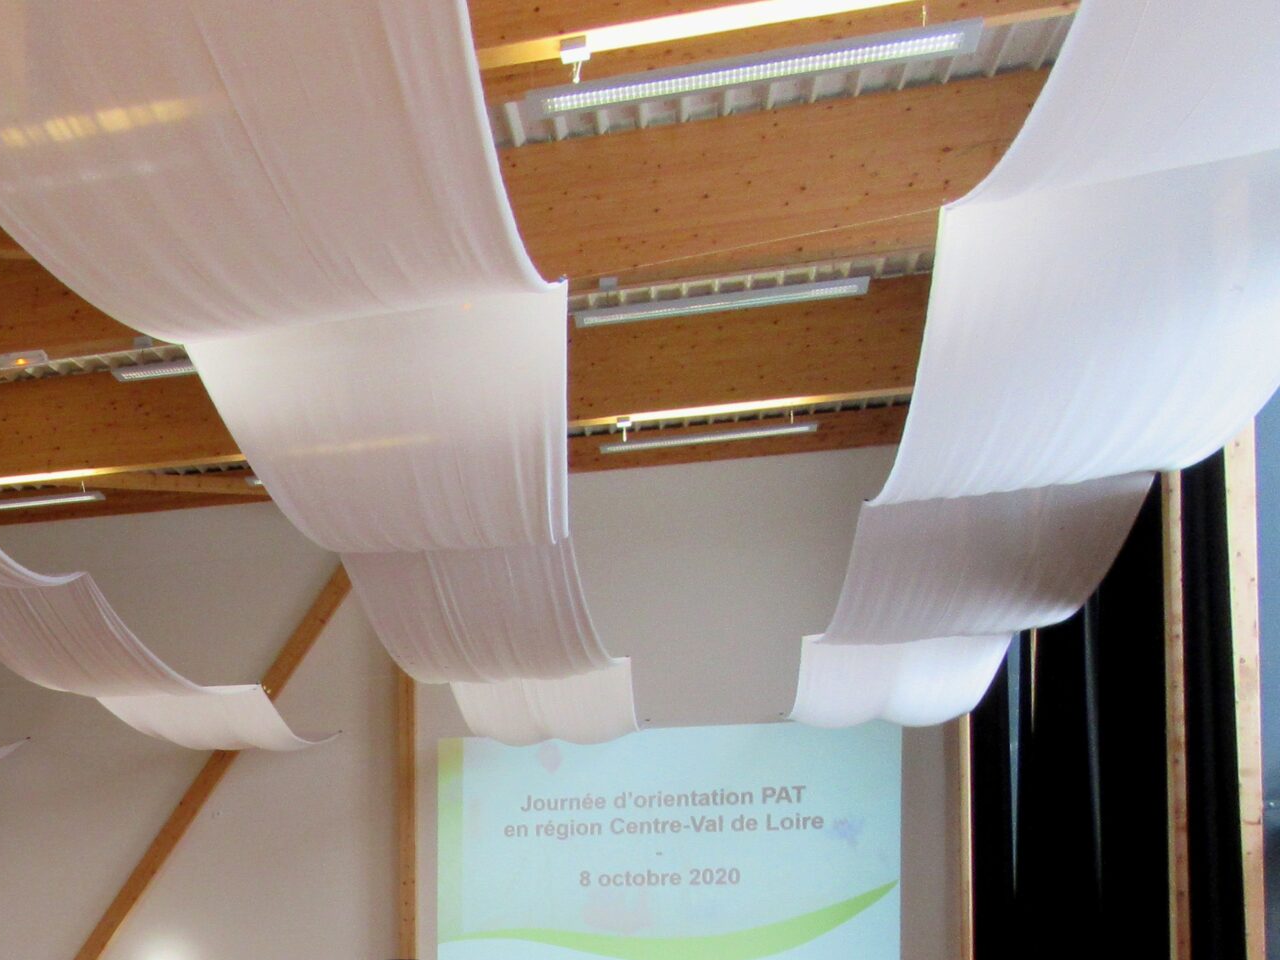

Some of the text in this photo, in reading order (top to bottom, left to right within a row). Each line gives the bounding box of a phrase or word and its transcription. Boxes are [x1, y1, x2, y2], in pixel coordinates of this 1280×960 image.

[521, 785, 806, 813] Journée d'orientation PAT
[504, 812, 825, 841] en région Centre-Val de Loire
[579, 867, 740, 887] 8 octobre 2020
